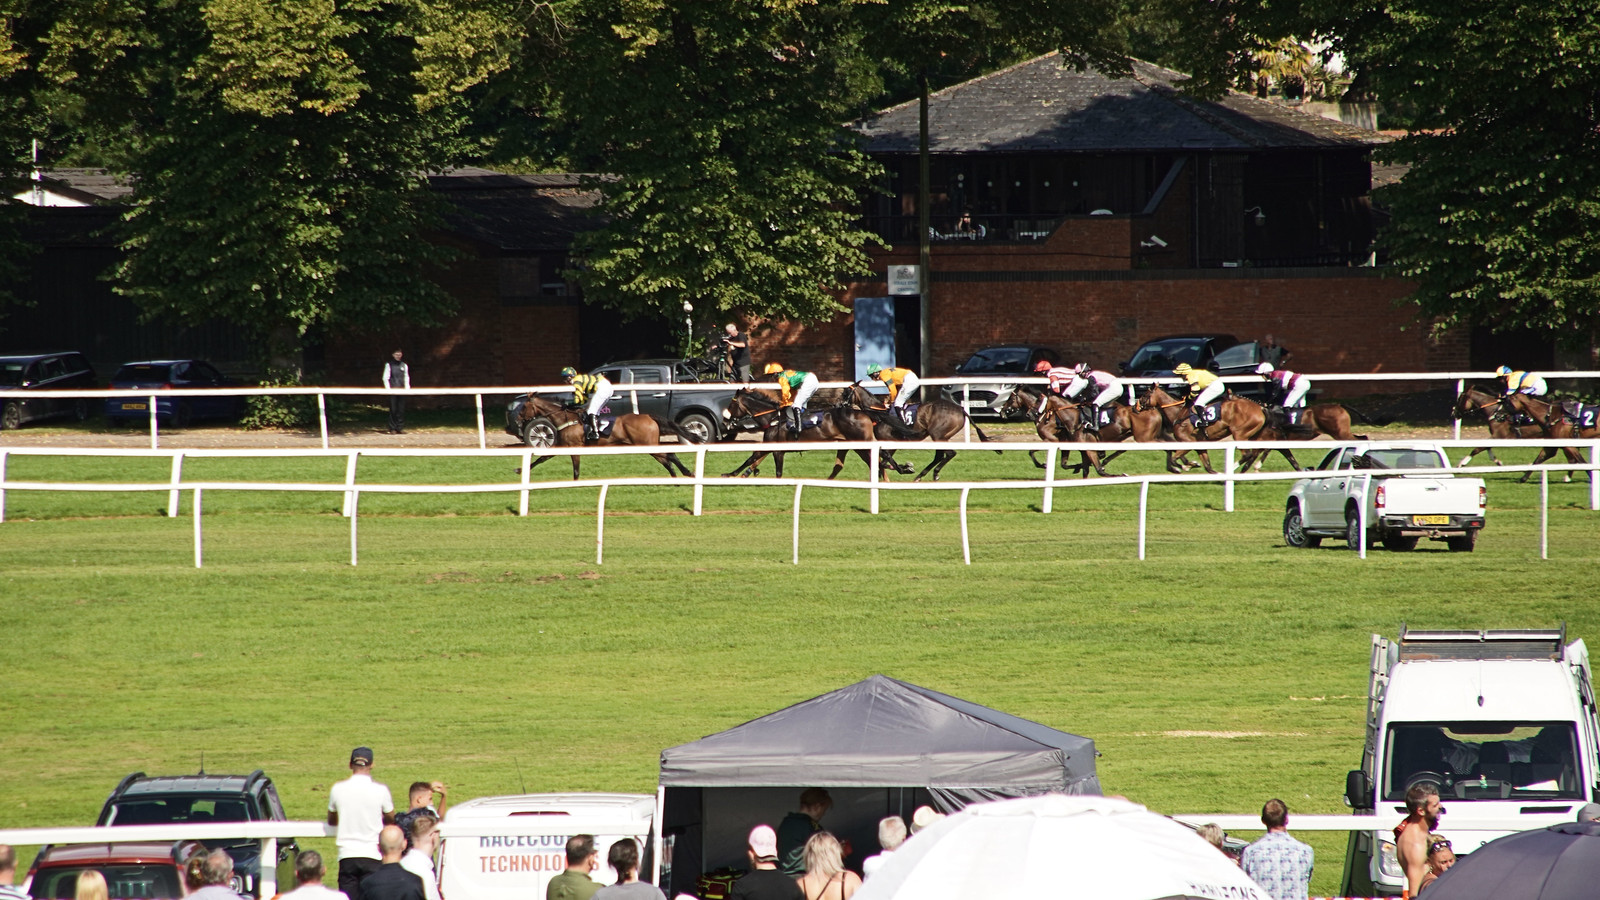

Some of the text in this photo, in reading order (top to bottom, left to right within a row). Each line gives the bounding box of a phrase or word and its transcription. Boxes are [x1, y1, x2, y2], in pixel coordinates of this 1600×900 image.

[1100, 410, 1110, 424] 4
[1206, 406, 1216, 421] 3
[1583, 410, 1594, 426] 2
[599, 419, 610, 432] 7
[479, 835, 600, 847] RACECOUE
[479, 854, 600, 873] TECHNOLOS
